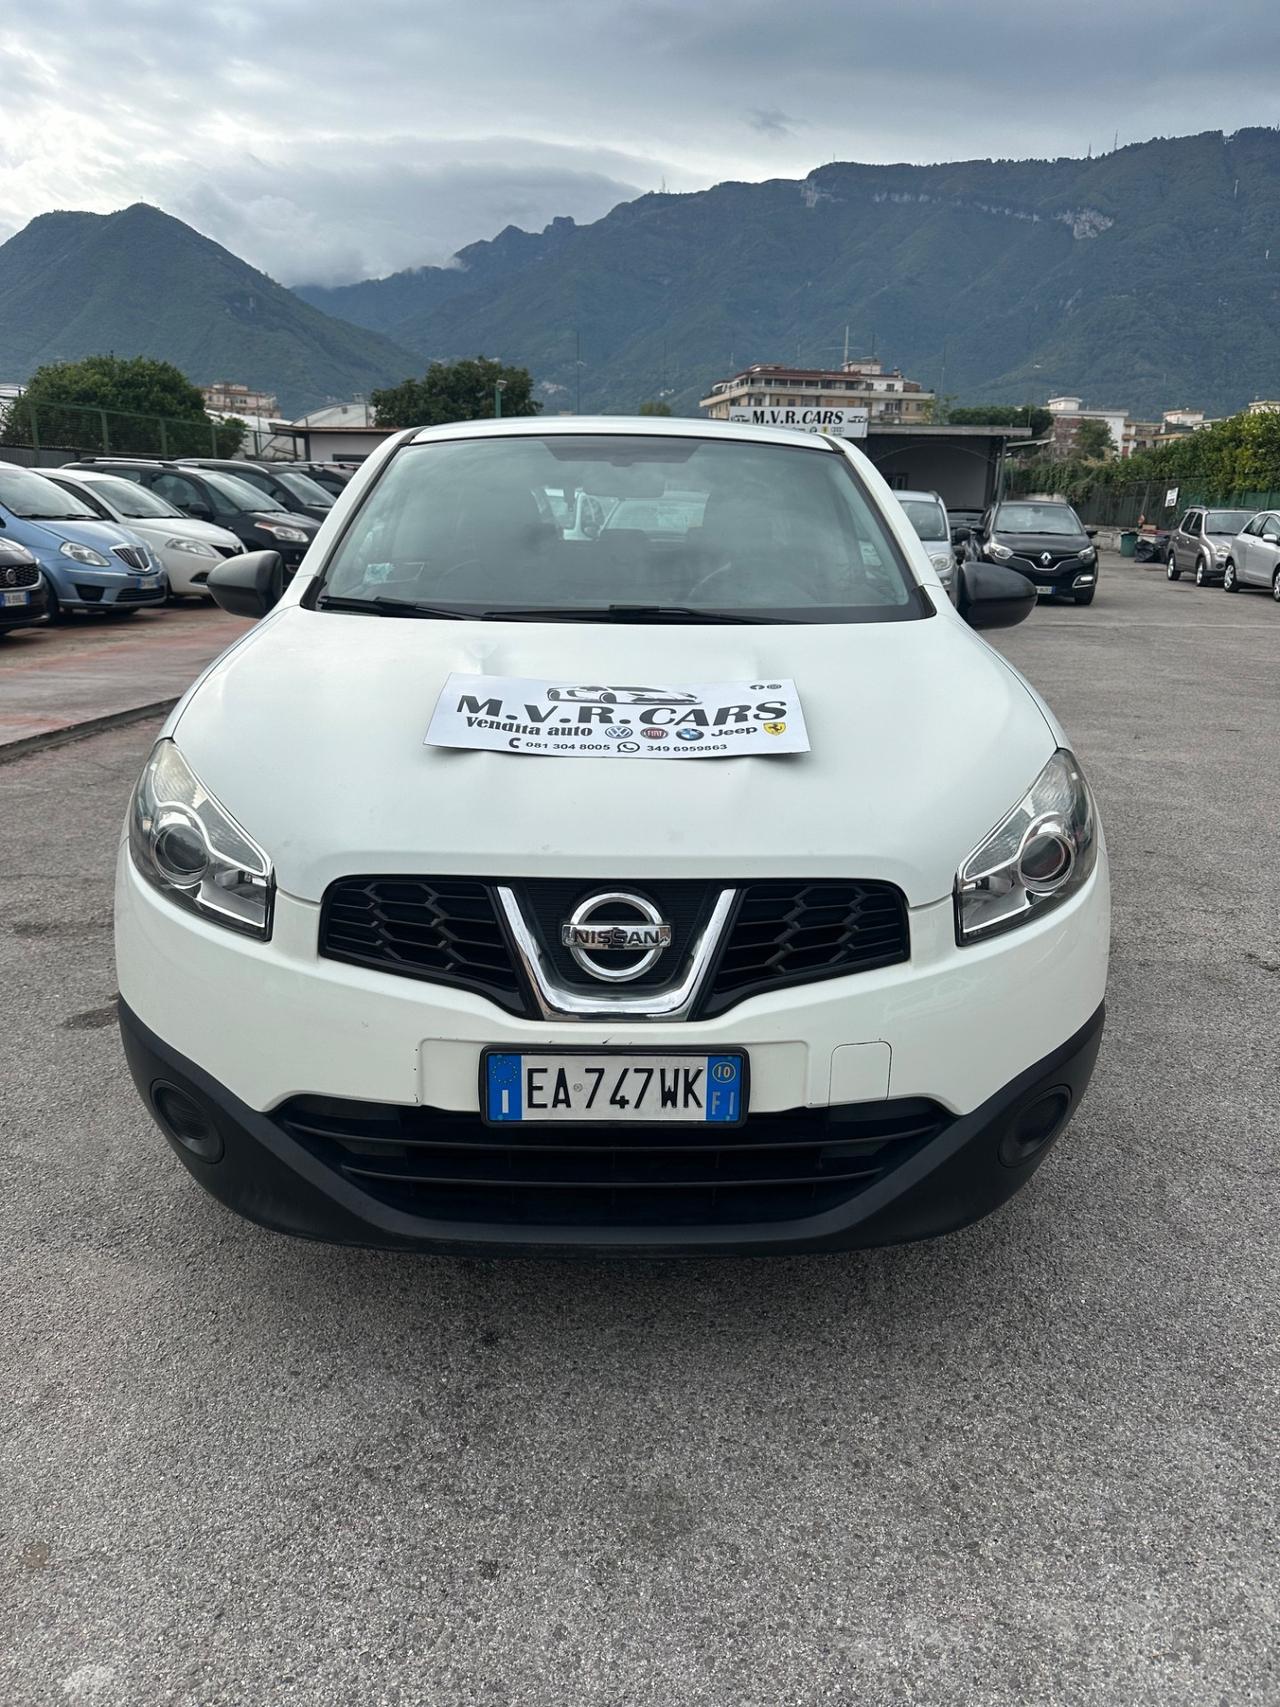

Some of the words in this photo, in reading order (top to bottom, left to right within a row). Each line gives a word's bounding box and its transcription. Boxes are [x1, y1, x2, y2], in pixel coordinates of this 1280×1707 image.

[466, 716, 541, 736] Vendita
[547, 726, 593, 737] auto
[711, 727, 758, 738] Jeep
[526, 741, 548, 749] 081
[580, 743, 610, 751] 8005
[673, 744, 728, 752] 6959863
[573, 928, 660, 945] NISSAN
[717, 1066, 731, 1078] 10
